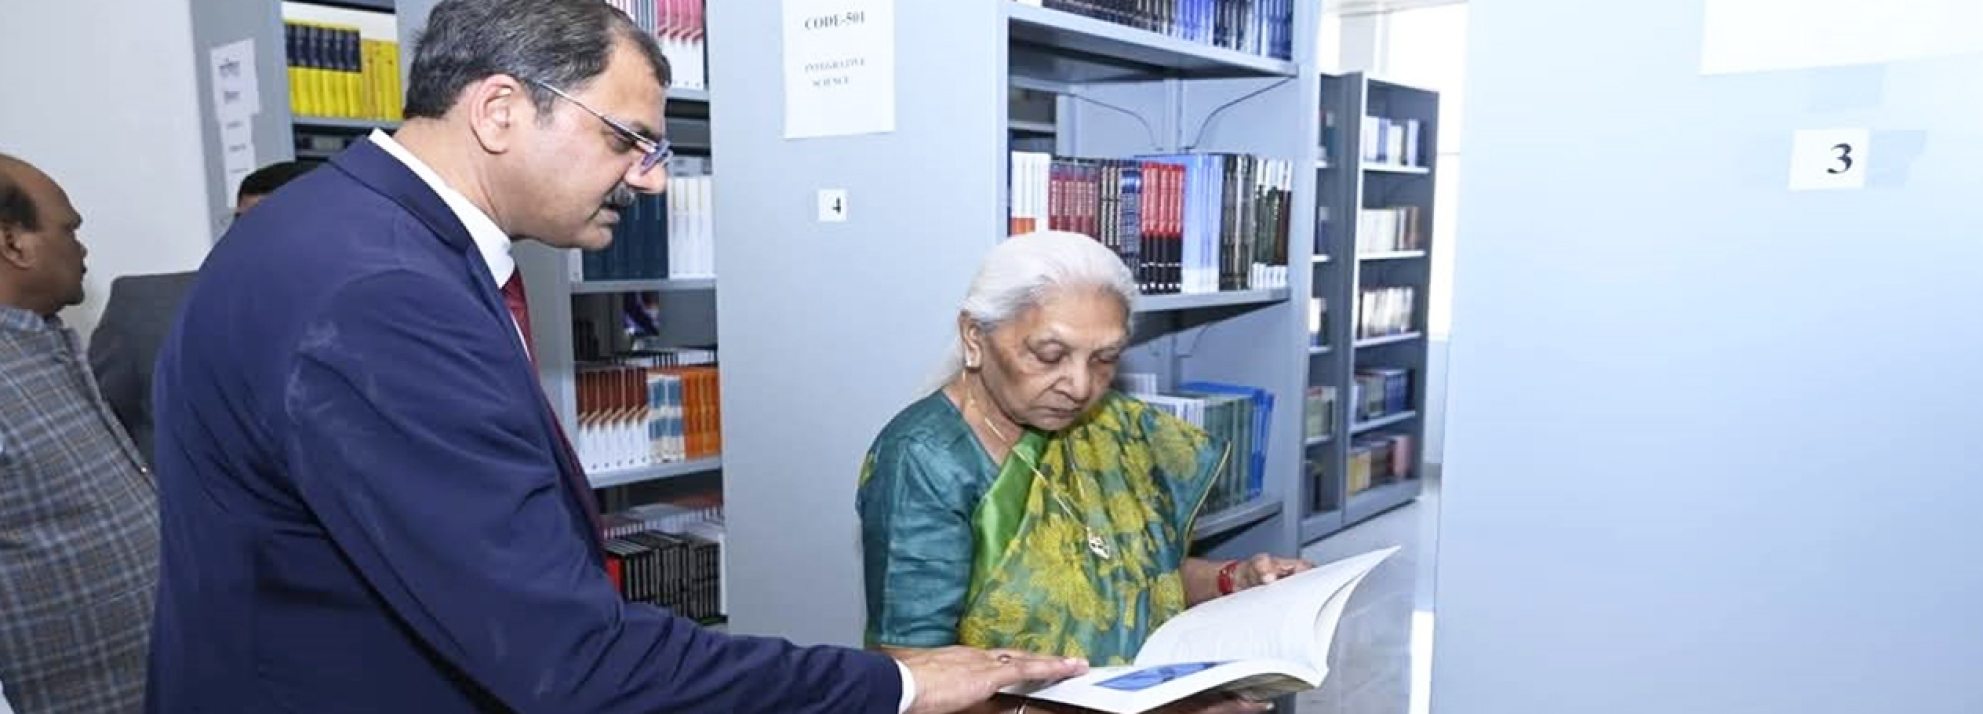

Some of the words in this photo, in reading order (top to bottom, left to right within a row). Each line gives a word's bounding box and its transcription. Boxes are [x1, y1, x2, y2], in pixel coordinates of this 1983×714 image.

[804, 10, 865, 30] CODE-501
[1827, 143, 1852, 174] 3
[831, 196, 842, 215] 4
